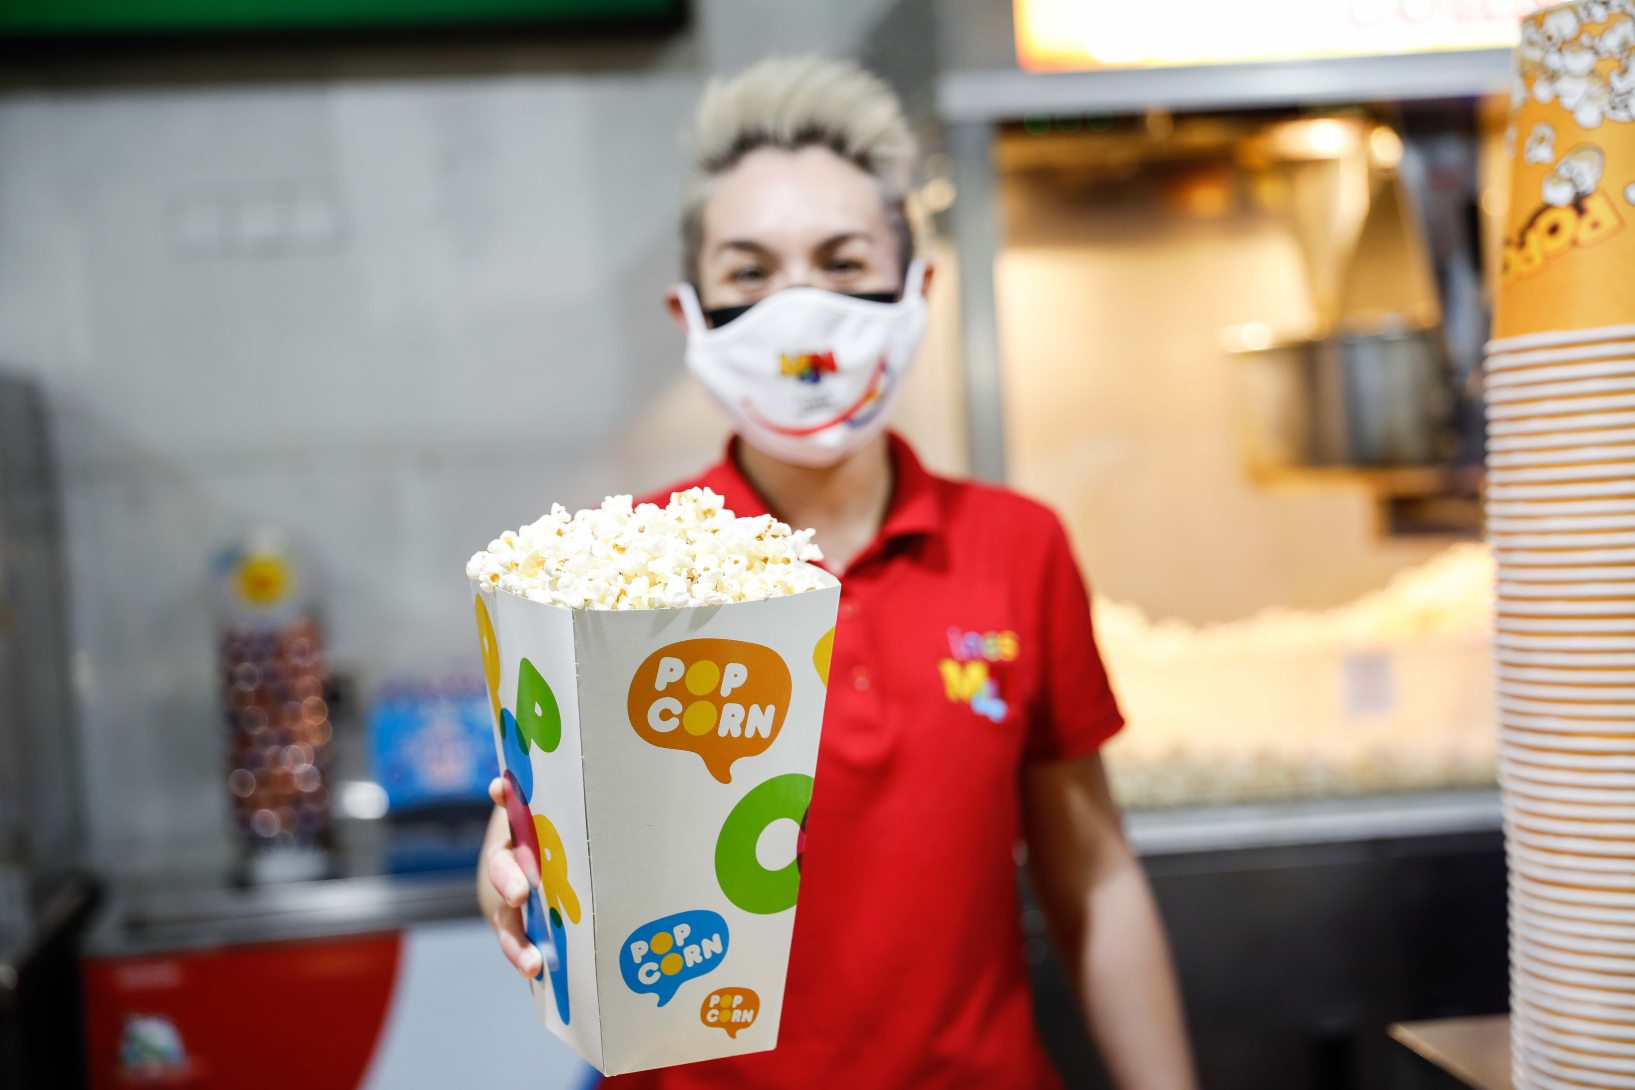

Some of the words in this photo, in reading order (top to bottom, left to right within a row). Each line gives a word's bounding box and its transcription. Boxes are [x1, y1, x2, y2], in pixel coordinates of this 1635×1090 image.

[655, 656, 748, 698] POP
[647, 696, 776, 739] CORN
[630, 923, 692, 964] POP
[637, 933, 723, 985] CORN
[706, 1009, 754, 1023] CORN
[709, 994, 743, 1009] POP
